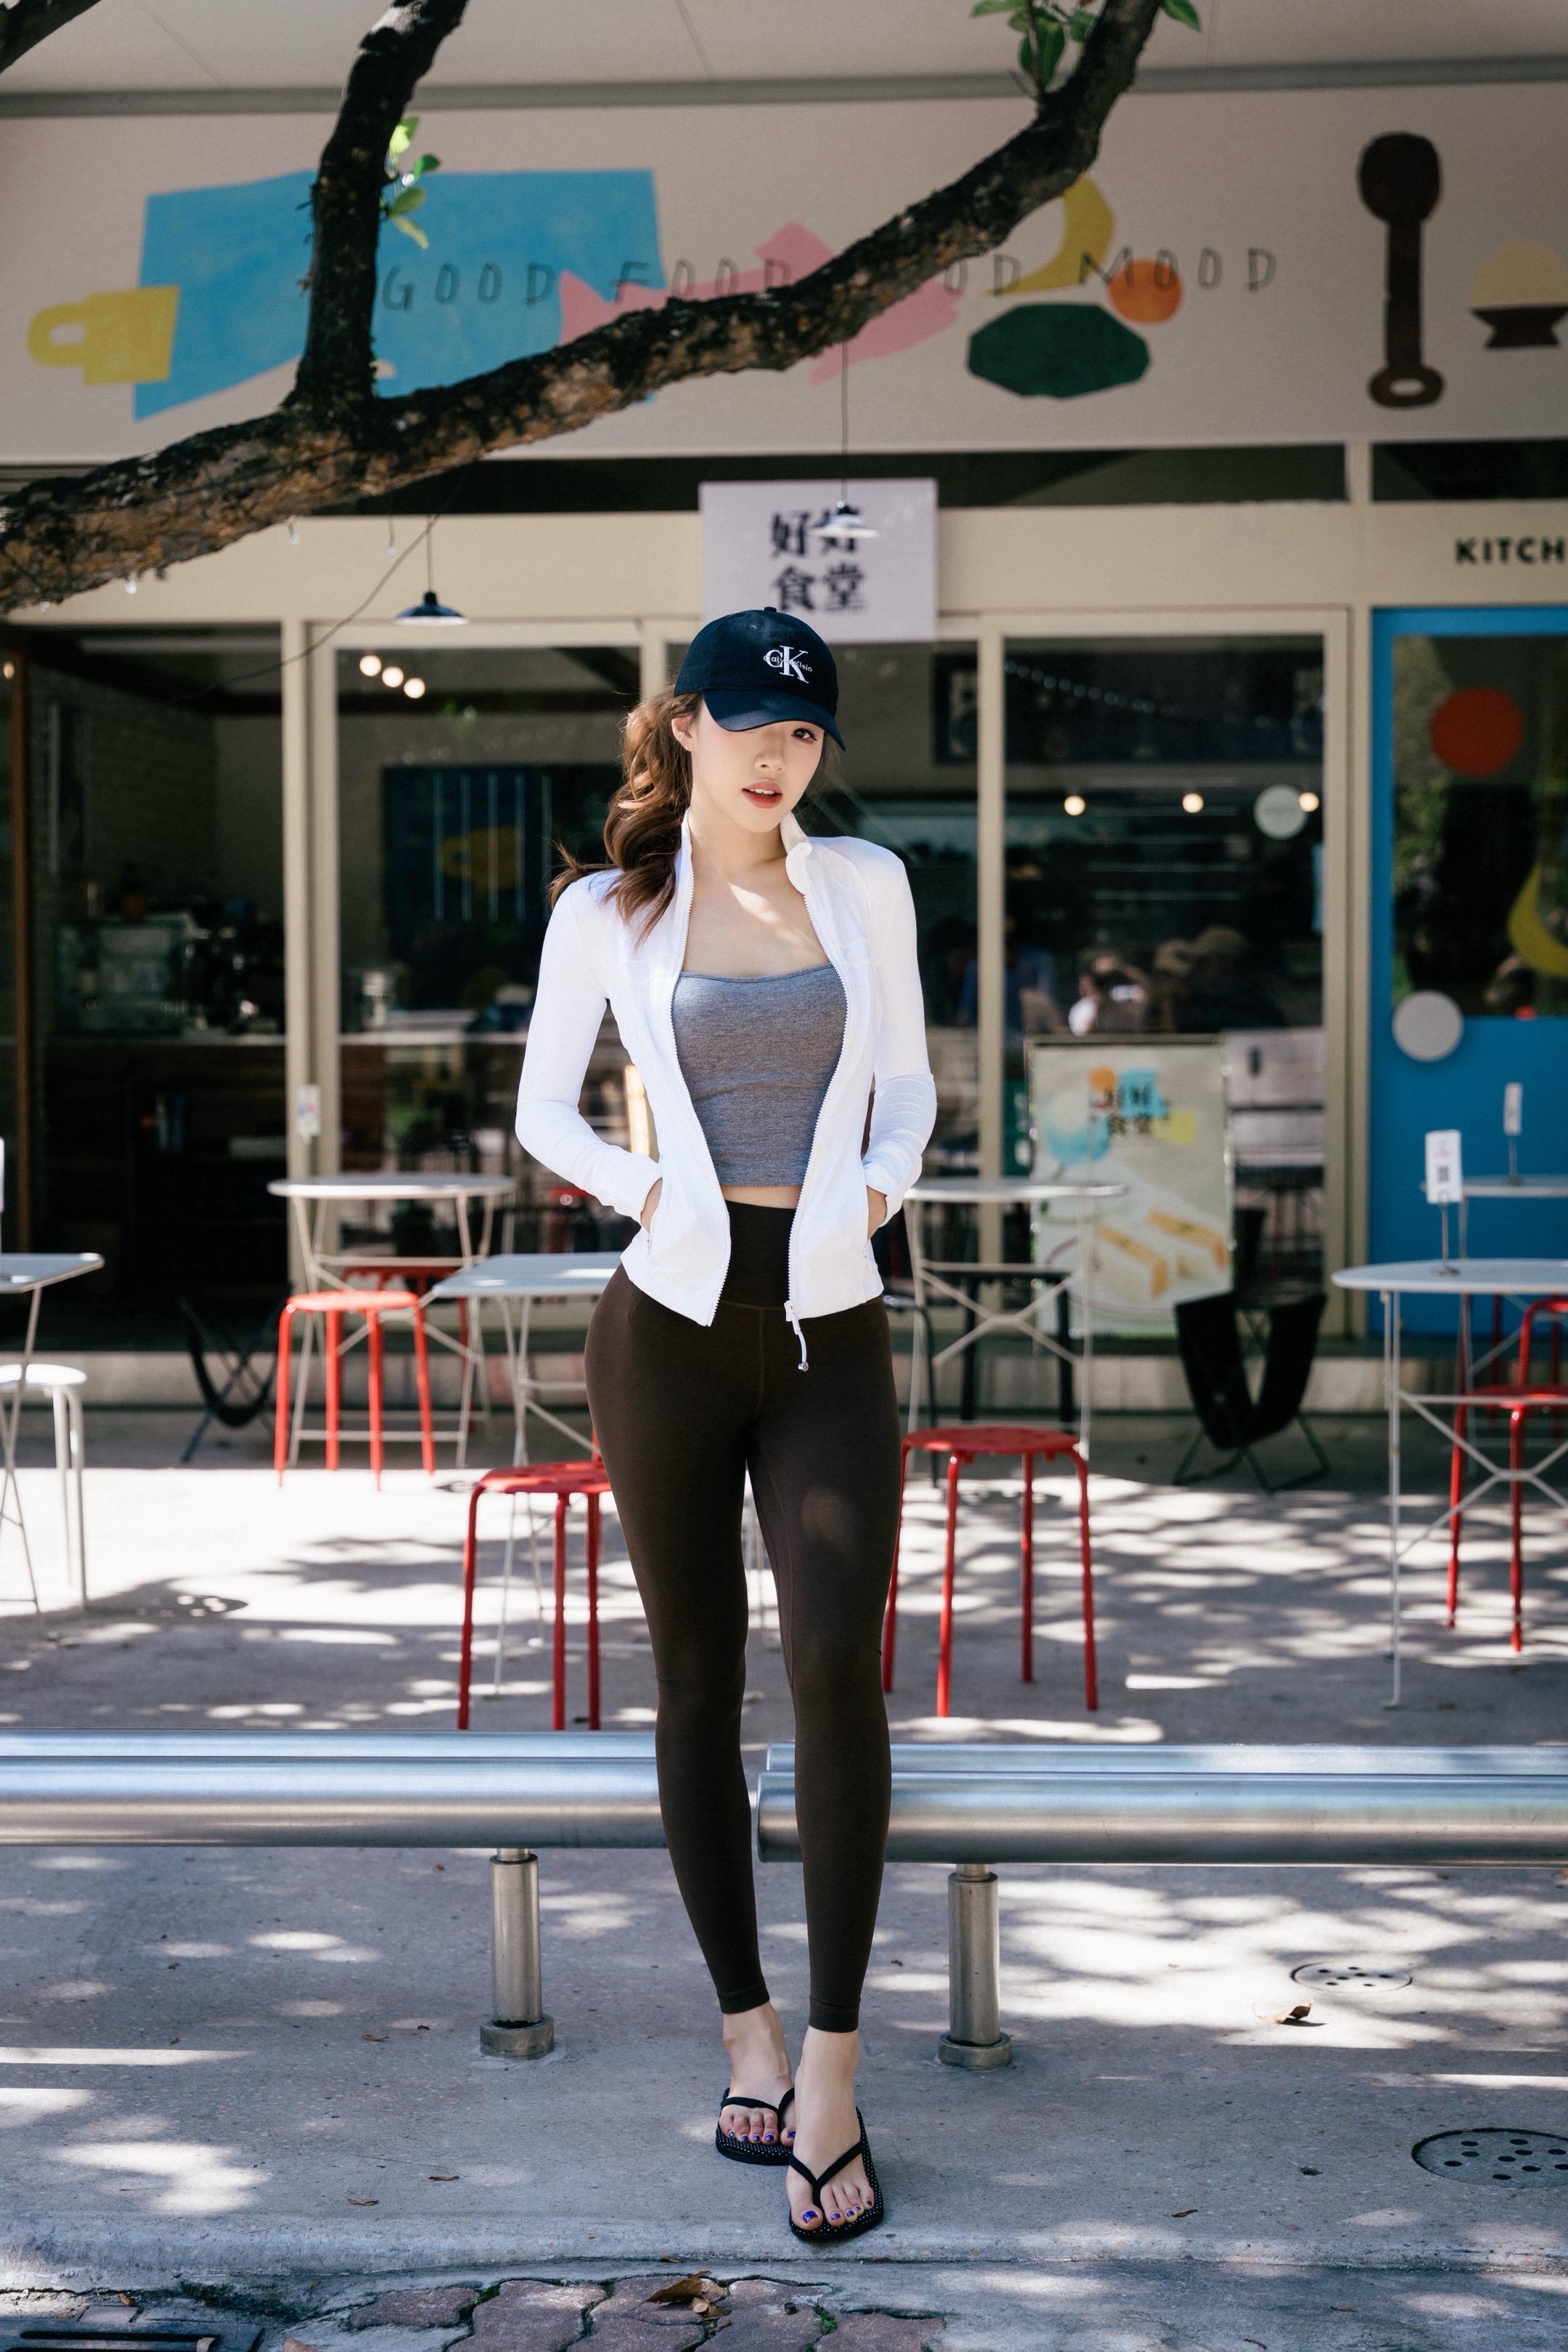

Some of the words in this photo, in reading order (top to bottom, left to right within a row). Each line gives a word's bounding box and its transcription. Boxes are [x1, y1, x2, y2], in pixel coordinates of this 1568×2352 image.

[381, 262, 557, 311] GOOD
[1078, 246, 1277, 293] MOOD
[1455, 536, 1567, 565] KITCH
[774, 563, 864, 611] 食堂
